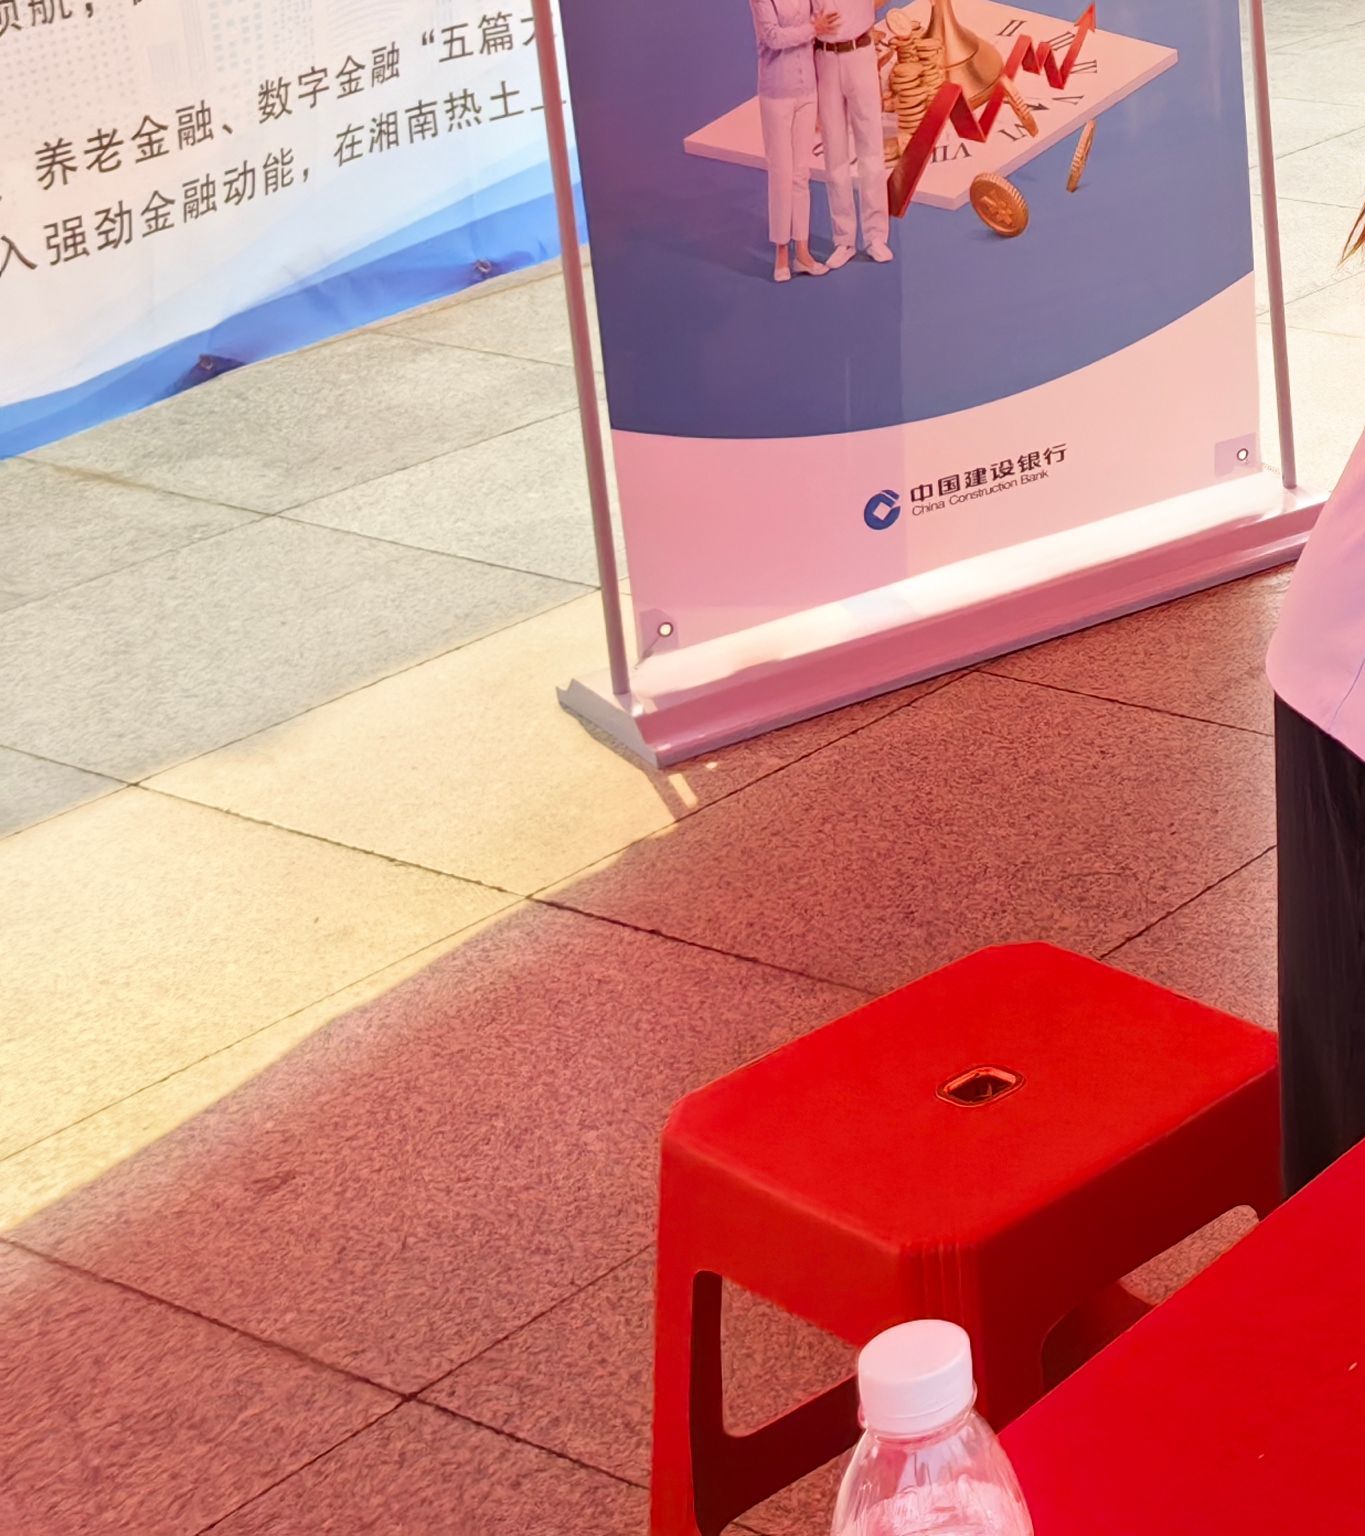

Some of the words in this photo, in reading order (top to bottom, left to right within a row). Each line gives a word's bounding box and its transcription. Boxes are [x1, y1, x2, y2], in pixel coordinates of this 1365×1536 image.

[910, 443, 1067, 503] 中国建设银行
[911, 500, 946, 516] China
[948, 477, 1018, 506] Construction
[1019, 469, 1050, 486] Bank
